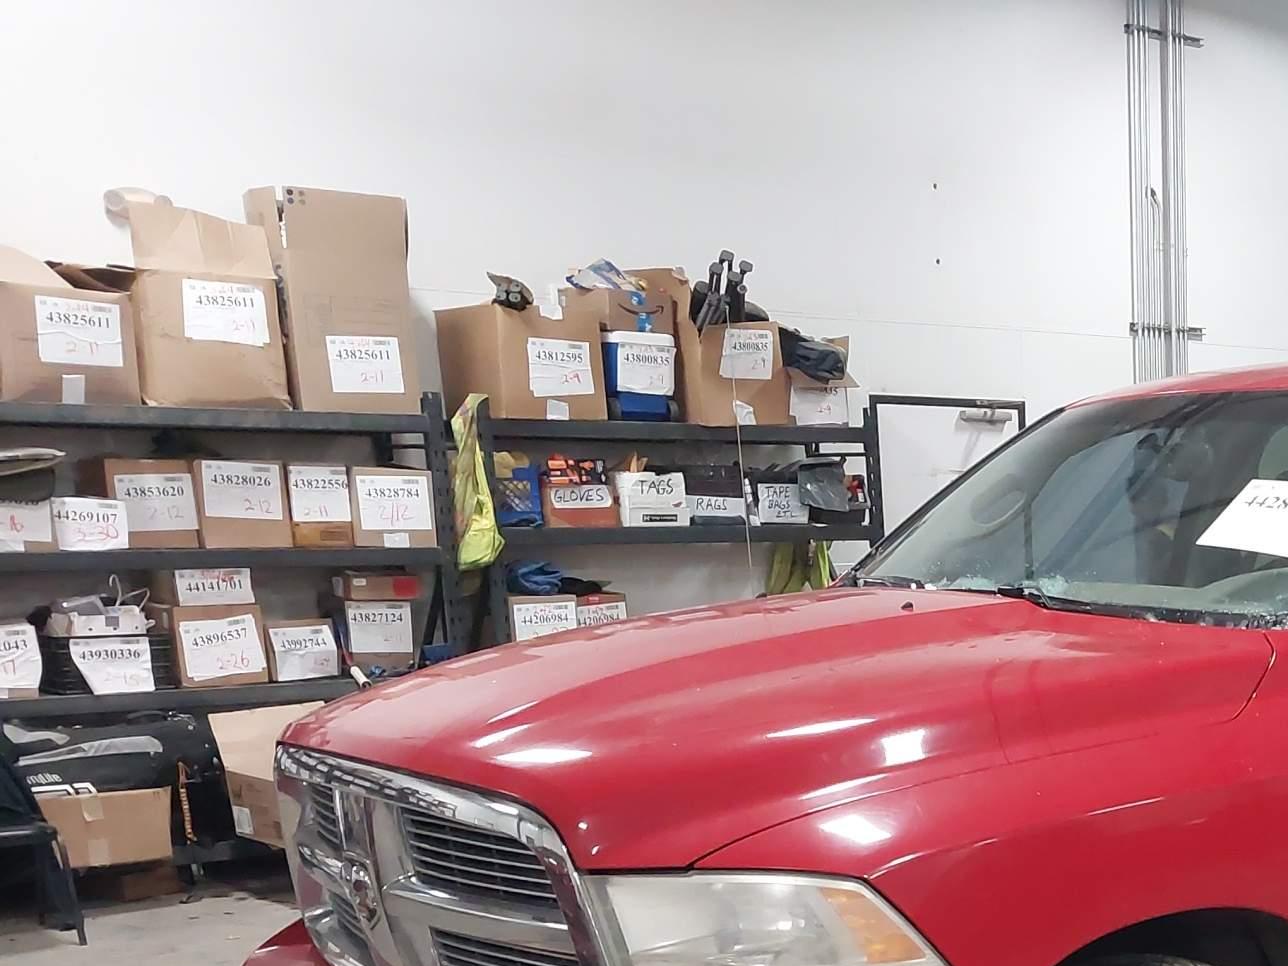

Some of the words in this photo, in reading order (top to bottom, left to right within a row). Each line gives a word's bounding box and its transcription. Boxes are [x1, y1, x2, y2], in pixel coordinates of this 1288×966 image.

[195, 295, 254, 309] 43825611
[46, 311, 110, 329] 43825611
[731, 342, 769, 352] 43800835
[335, 348, 391, 361] 43825611
[535, 350, 584, 363] 43812595
[623, 352, 670, 367] 43800835
[210, 473, 272, 488] 43828026
[292, 478, 348, 490] 43822556
[124, 486, 184, 499] 43853620
[364, 487, 420, 500] 43828784
[638, 479, 674, 496] TAGS
[765, 485, 790, 498] TAPE
[553, 487, 605, 503] GLOVES
[696, 497, 727, 511] RAGS
[54, 509, 118, 524] 44269107
[185, 578, 243, 592] 44141701
[350, 612, 404, 624] 43827124
[521, 612, 569, 625] 44206984
[191, 627, 248, 648] 43896537
[279, 638, 328, 649] 43992744
[79, 648, 141, 661] 43930336
